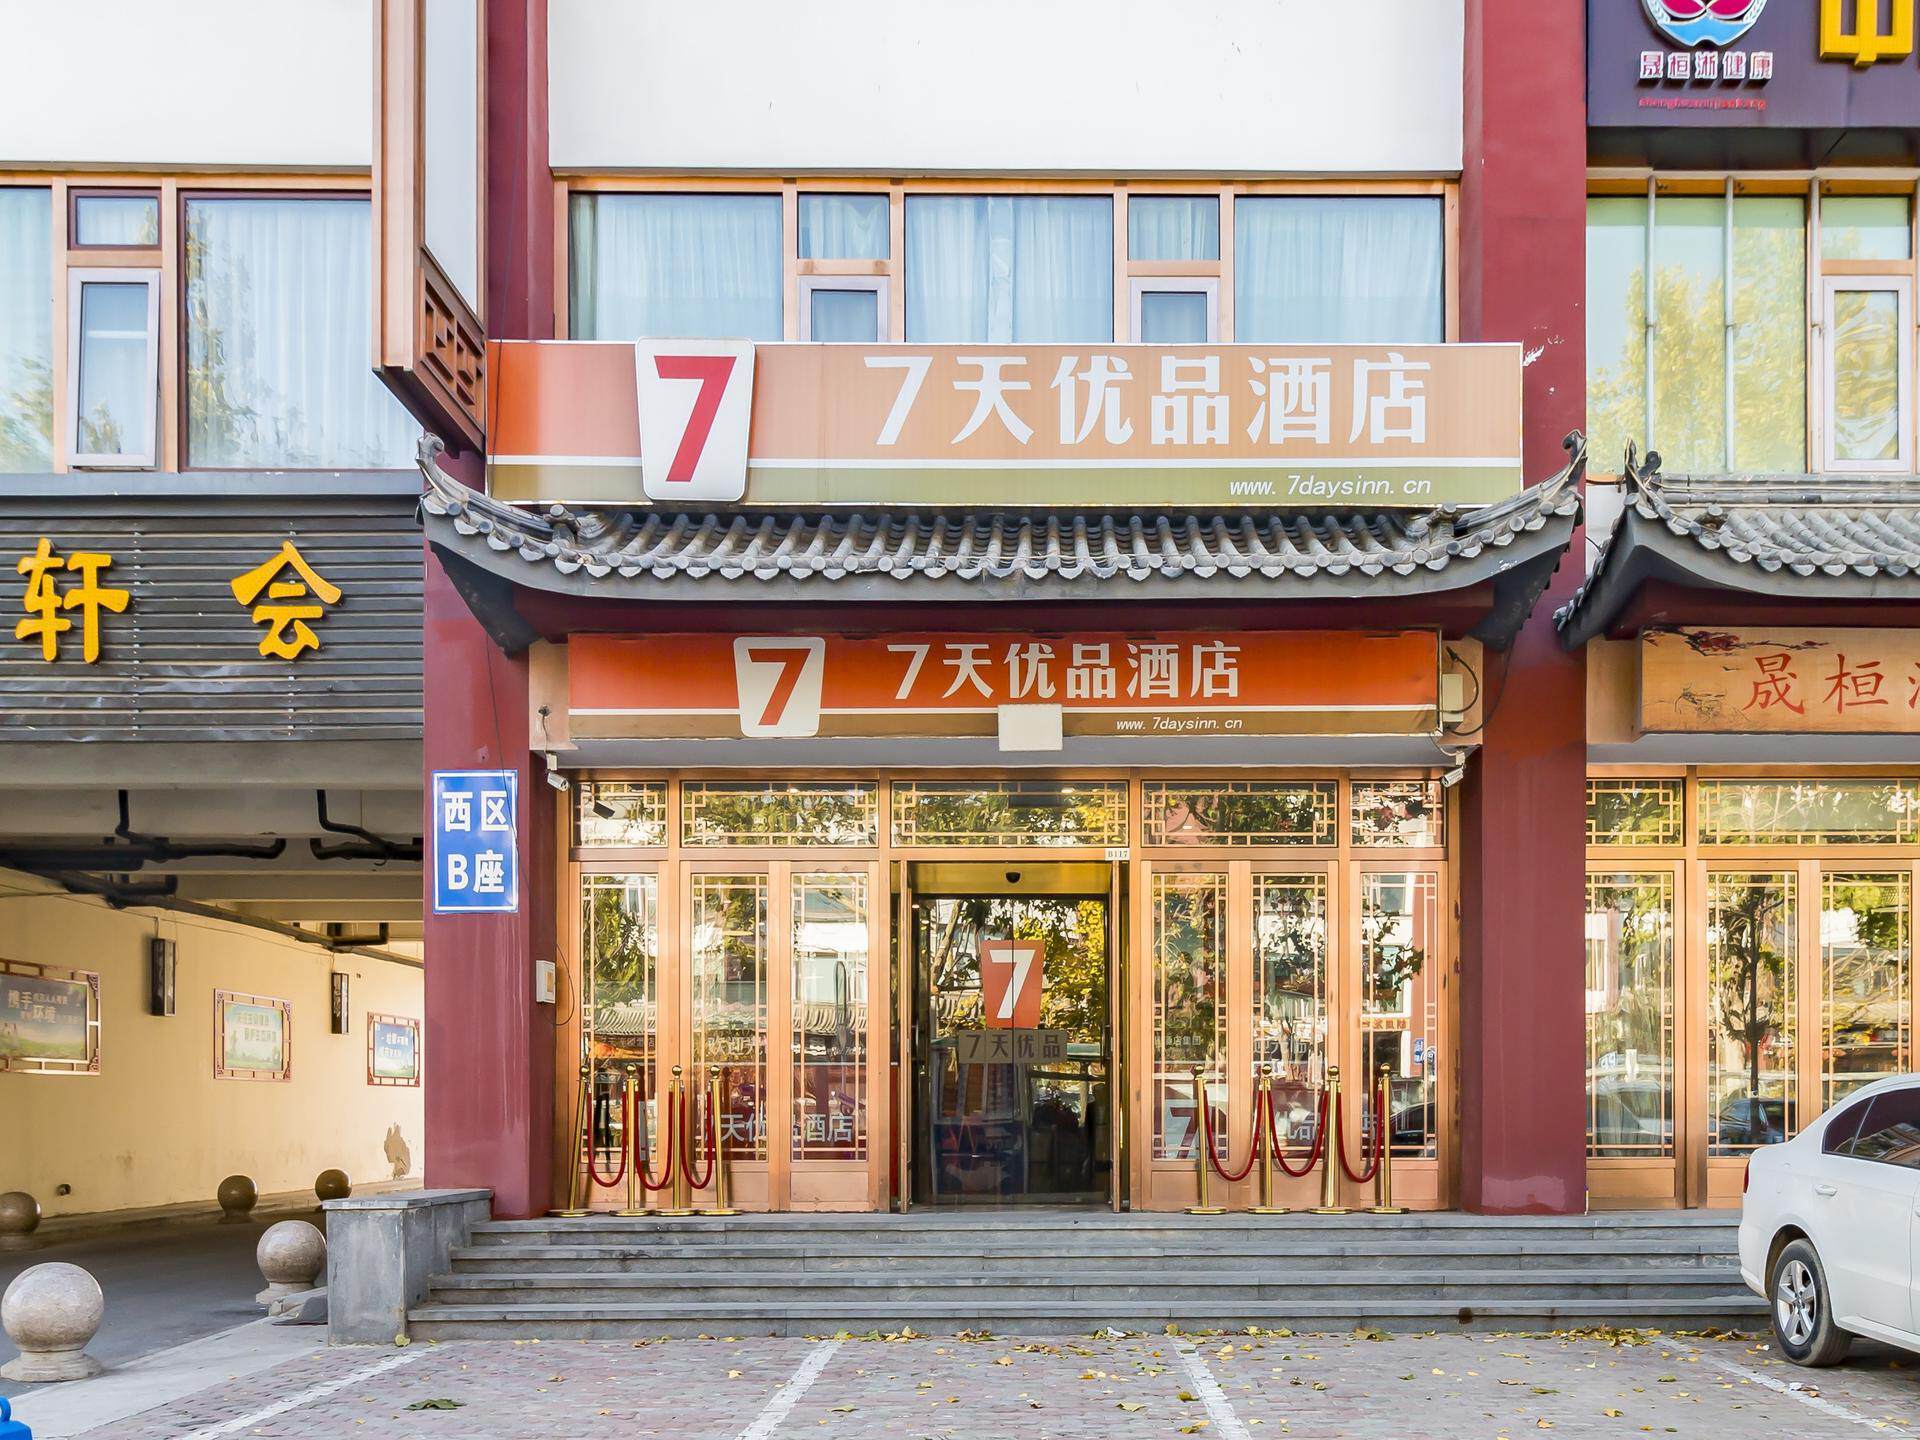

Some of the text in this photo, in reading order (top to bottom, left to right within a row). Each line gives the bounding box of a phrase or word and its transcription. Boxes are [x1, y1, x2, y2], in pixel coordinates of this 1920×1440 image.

[654, 355, 737, 482] 7
[864, 352, 1431, 446] 7天优品酒店
[747, 648, 812, 726] 7
[887, 640, 1241, 700] 7天优品酒店
[441, 790, 510, 832] 西区
[447, 849, 505, 893] B座
[989, 949, 1036, 1018] 7
[965, 1034, 1061, 1059] 7天优品
